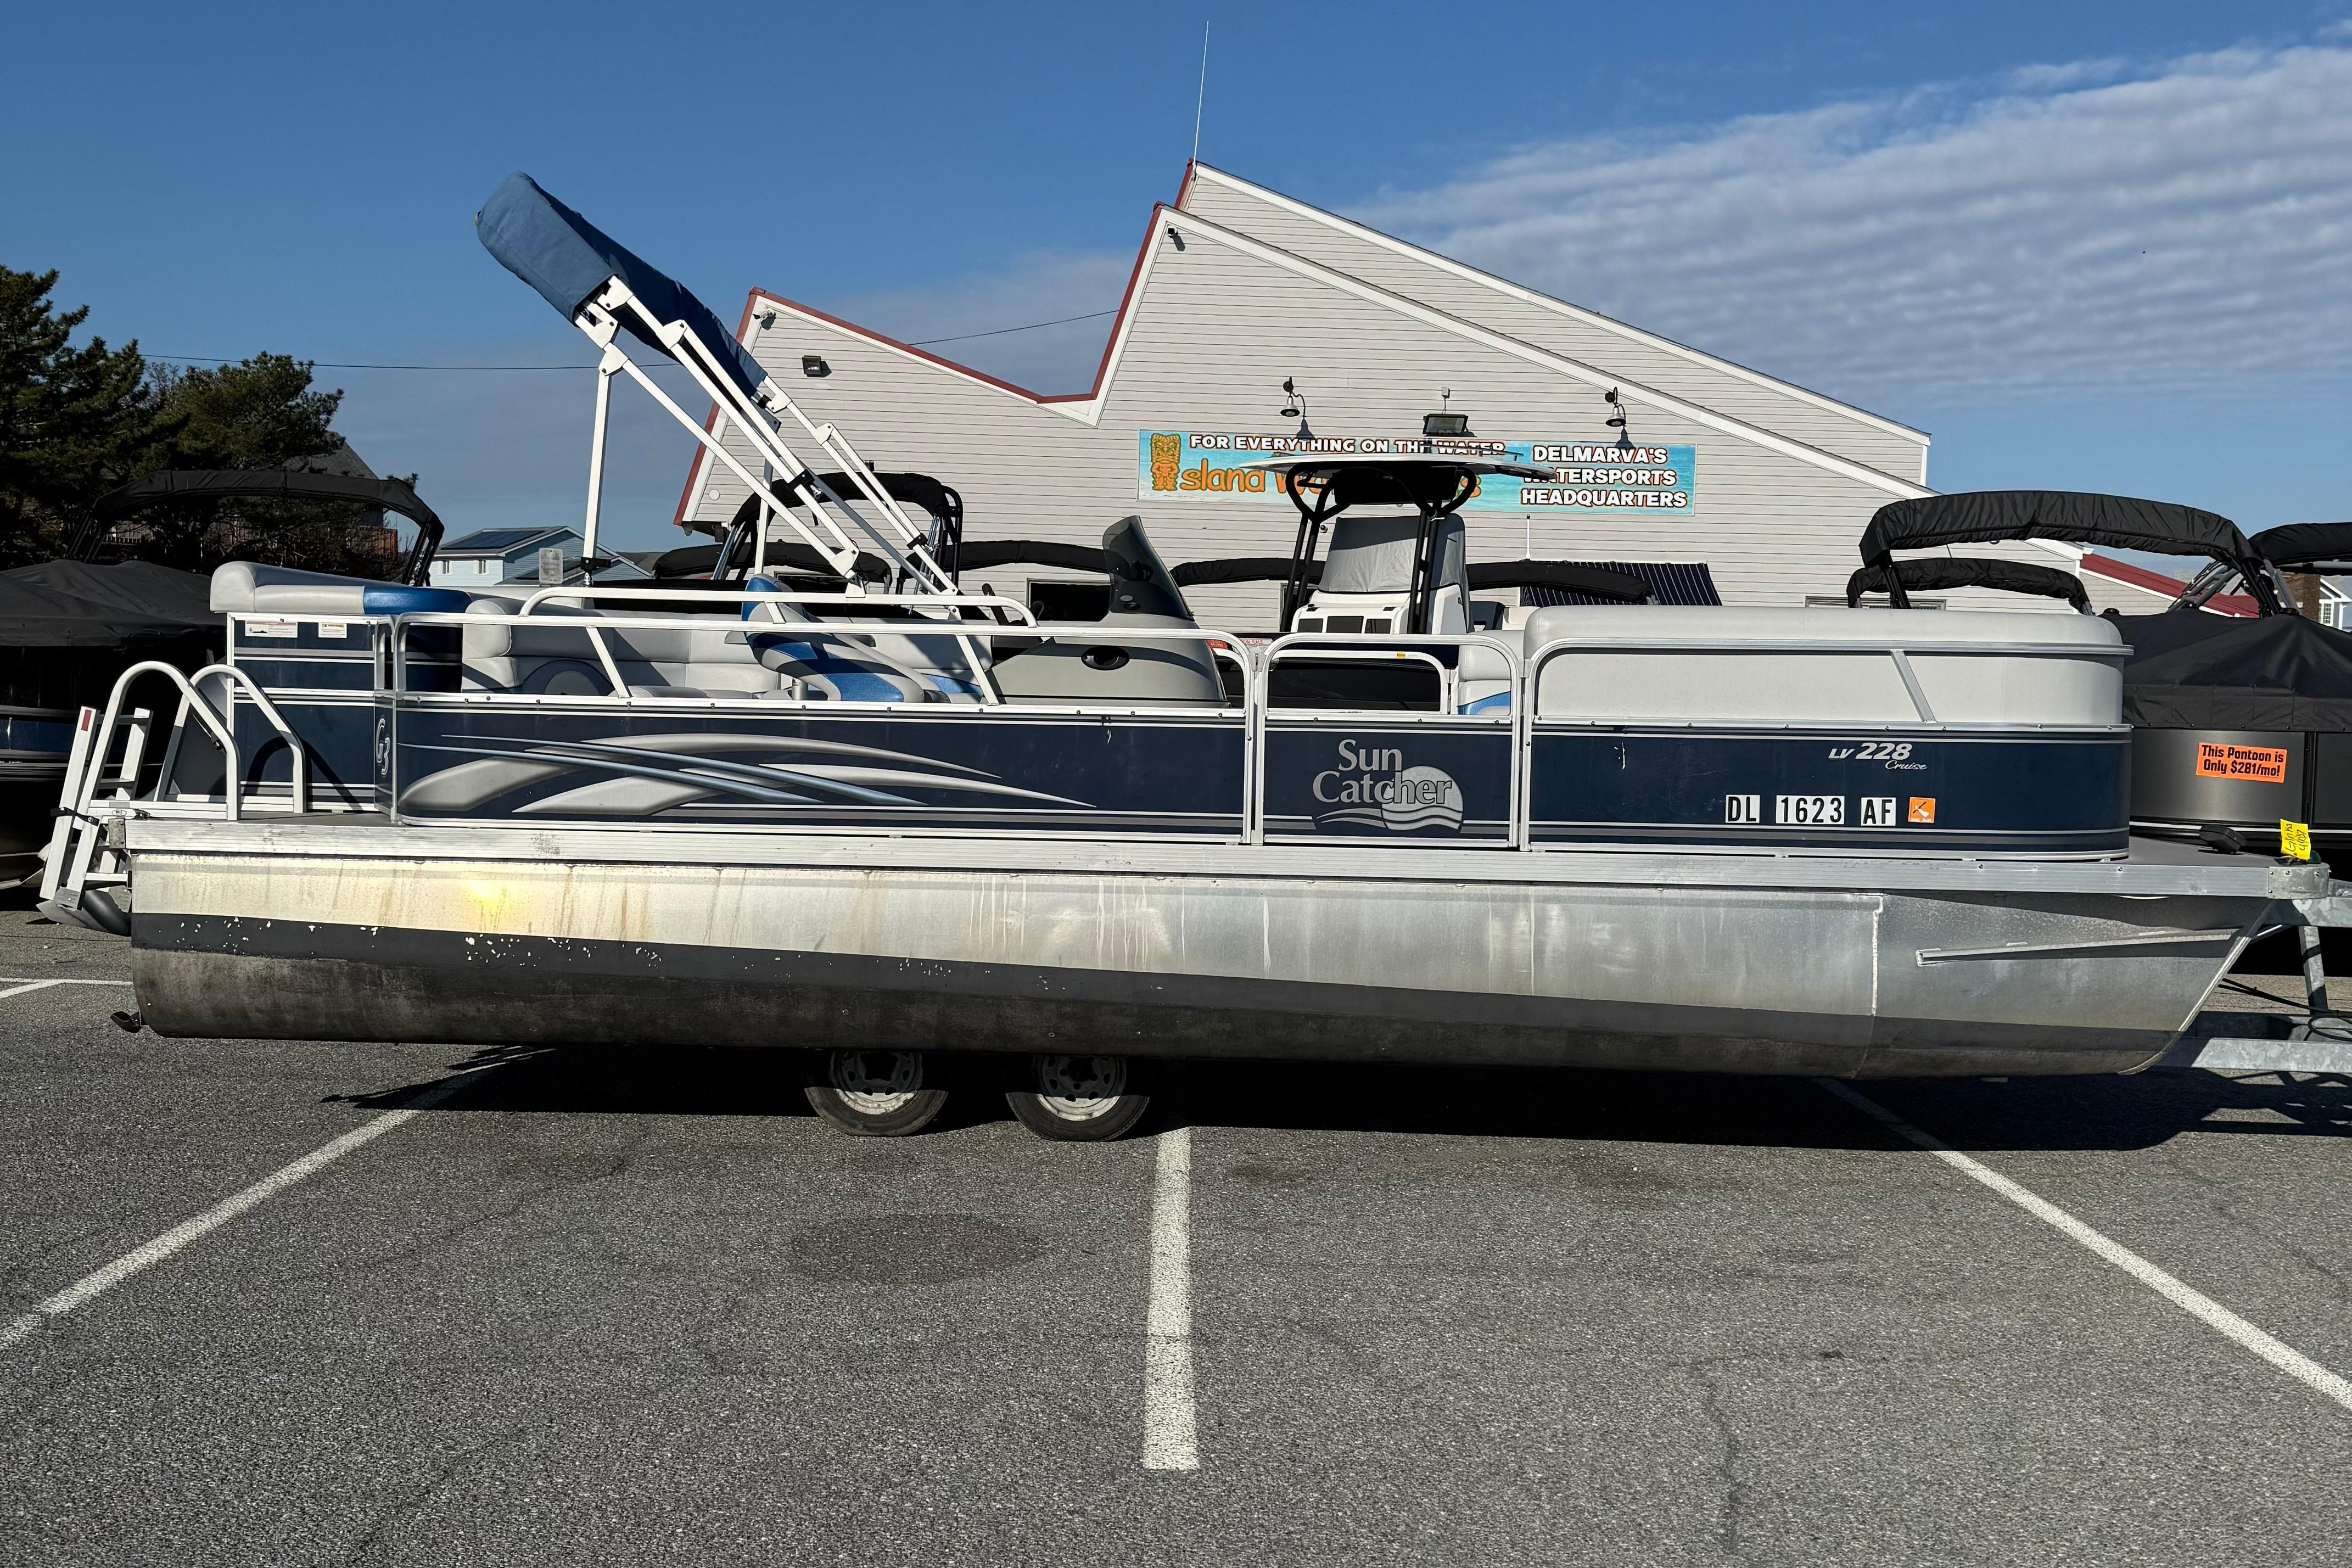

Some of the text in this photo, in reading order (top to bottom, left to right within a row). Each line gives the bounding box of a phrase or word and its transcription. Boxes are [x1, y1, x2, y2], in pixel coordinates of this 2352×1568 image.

[1190, 434, 1229, 449] FOR
[1235, 436, 1356, 453] EVERYTHING
[1361, 439, 1389, 453] ON
[1533, 445, 1668, 464] DELMARVA'S
[1524, 467, 1677, 486] TERSPORTS
[1521, 489, 1688, 507] HEADQUARTERS
[1338, 739, 1402, 771] Sun
[1828, 742, 1912, 760] LV 228
[2202, 744, 2284, 763] This Pontoon is
[1885, 760, 1928, 770] Cruise
[2204, 759, 2281, 776] Only $281/mo!
[1313, 770, 1452, 804] Catcher
[1727, 796, 1893, 824] DL 1623 AF
